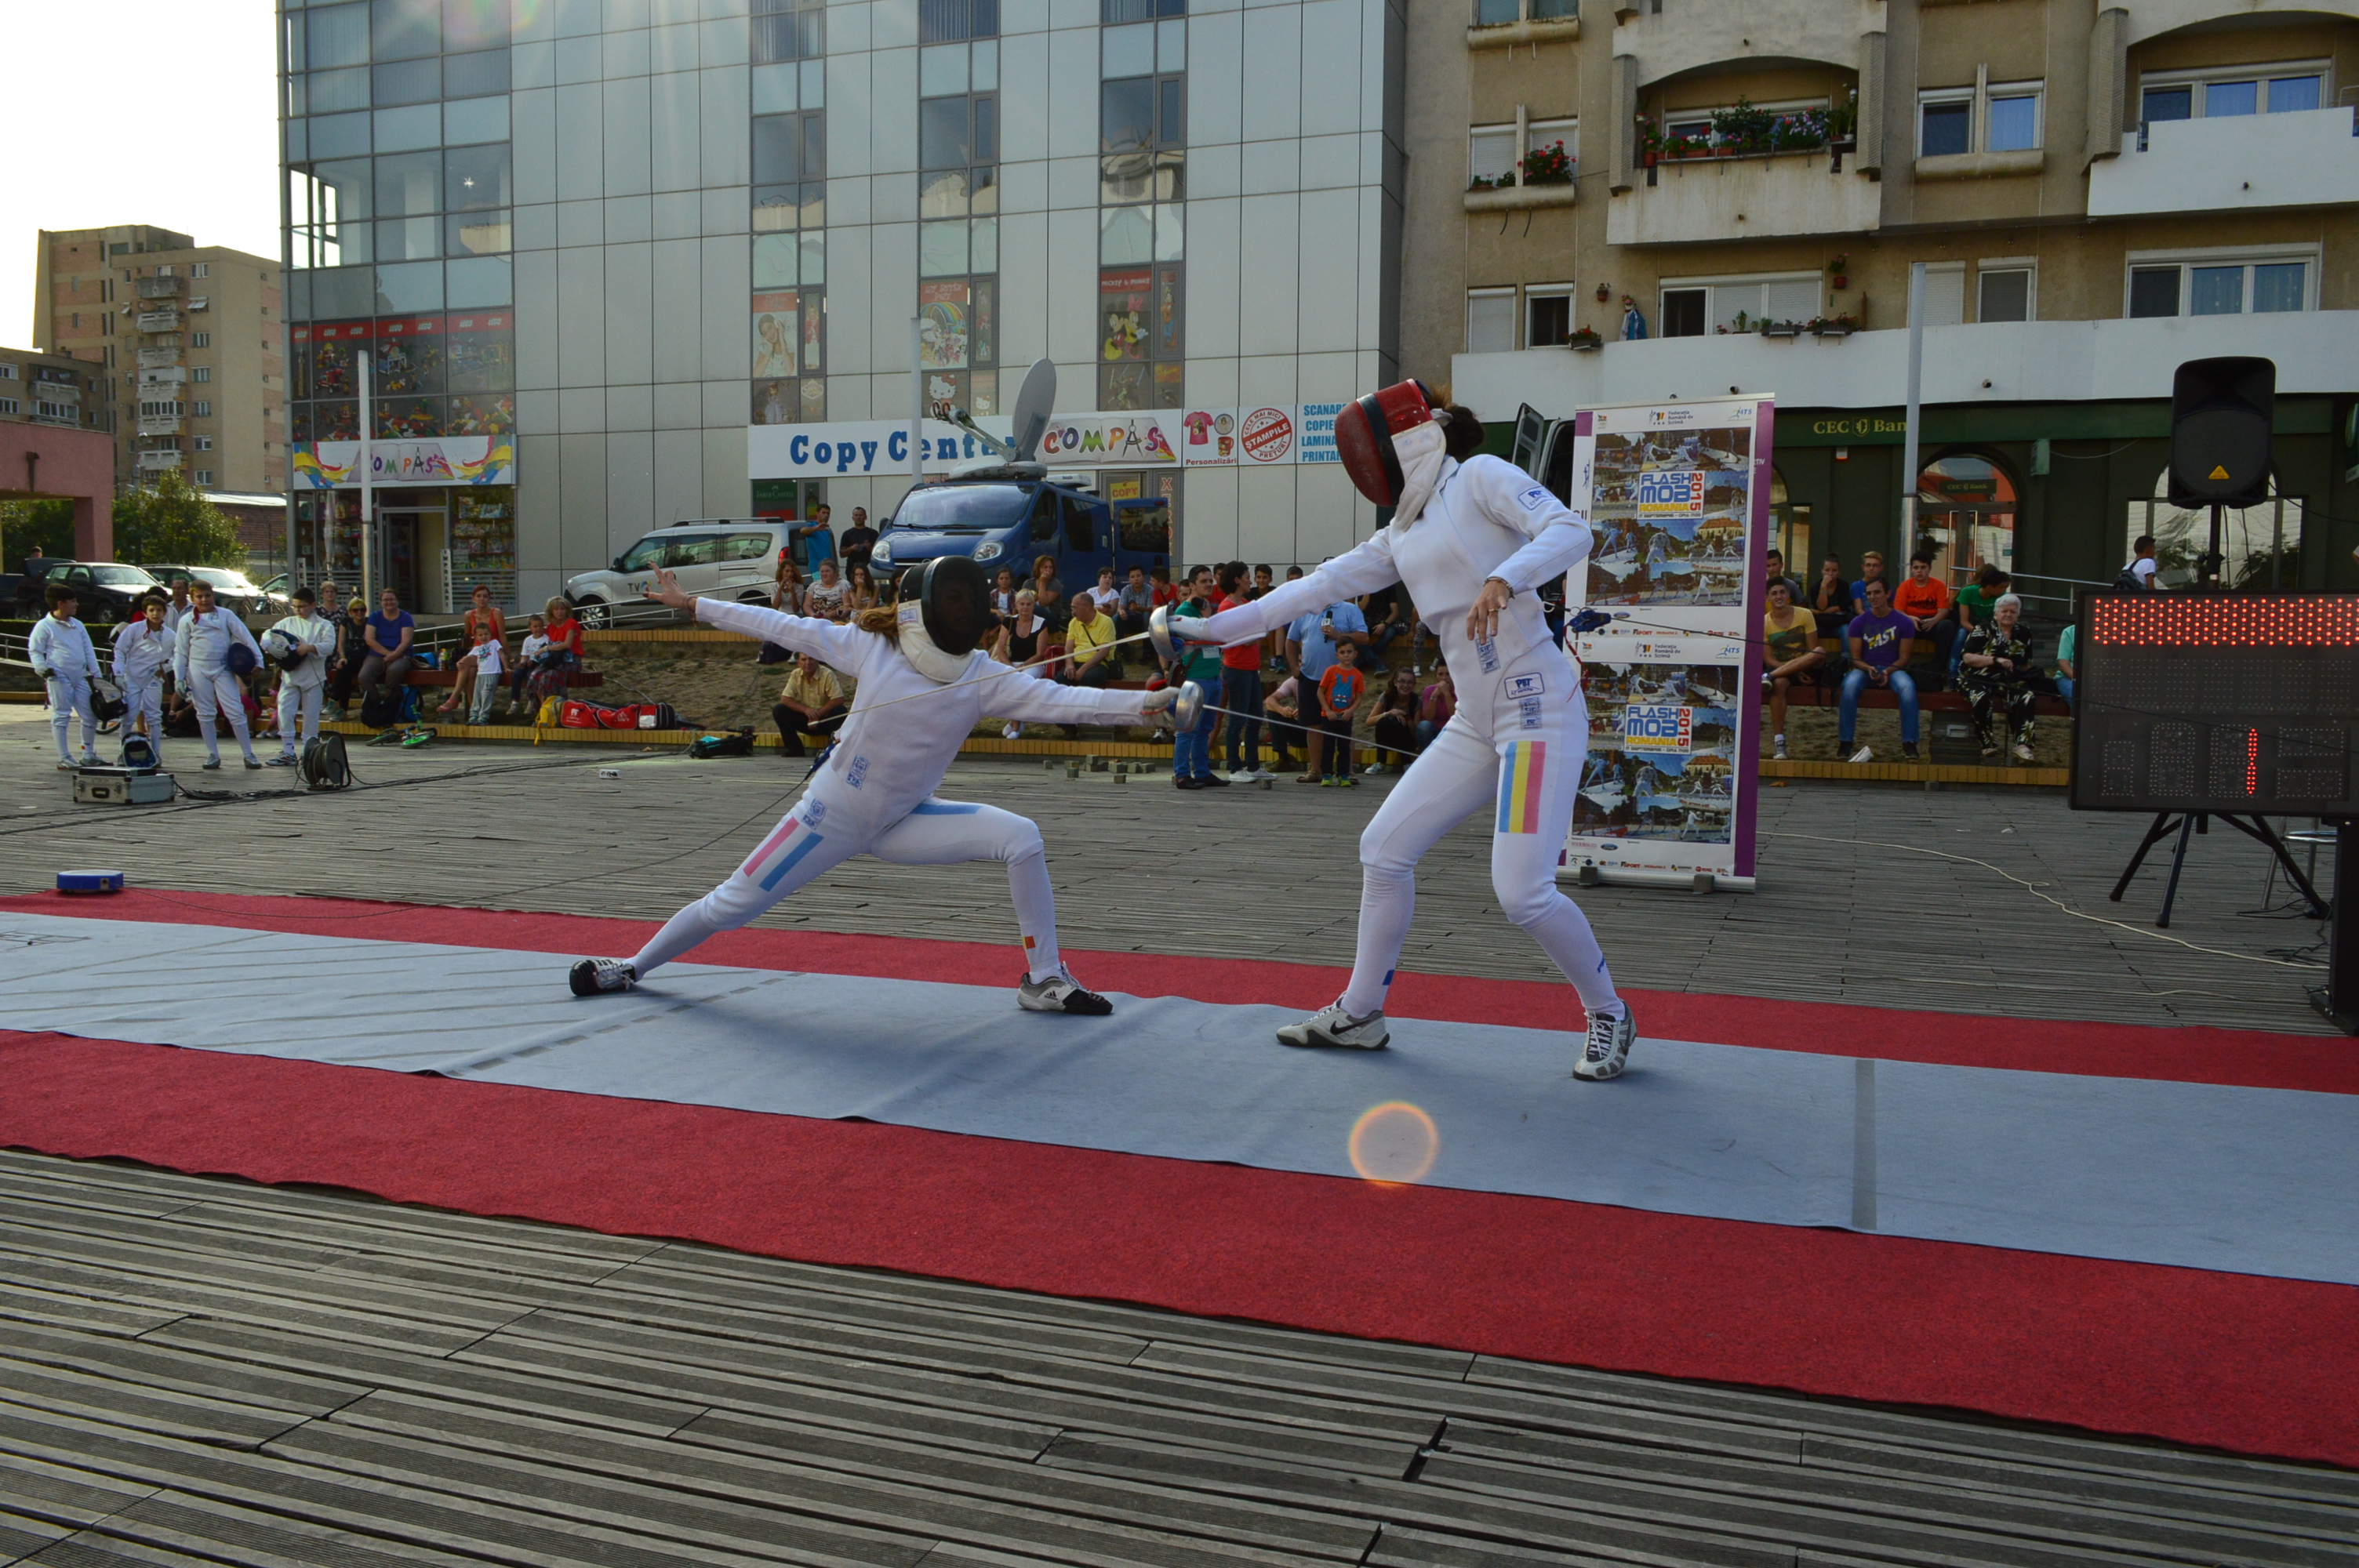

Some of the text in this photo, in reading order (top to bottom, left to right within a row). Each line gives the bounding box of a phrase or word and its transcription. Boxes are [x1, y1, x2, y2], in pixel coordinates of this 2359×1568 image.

[1101, 278, 1121, 287] MICKEY
[389, 324, 403, 332] LEGO
[488, 318, 501, 326] LEGO
[1254, 411, 1267, 419] MAI
[1267, 411, 1281, 419] MICI
[1303, 403, 1347, 416] SCANAR
[1813, 419, 1907, 434] CEC Ban
[1044, 419, 1159, 457] COMPAS
[790, 435, 878, 472] Copy
[370, 447, 433, 474] OMPAS
[1186, 457, 1237, 466] Personalizări
[1112, 487, 1138, 498] COPY
[1640, 485, 1691, 503] MOB
[1641, 473, 1703, 511] FLASH 2015
[1639, 503, 1689, 512] ROMANIA
[1515, 677, 1533, 688] PBT
[1627, 706, 1691, 746] FLASH 2015
[1627, 718, 1678, 737] MOB
[1626, 735, 1677, 746] ROMANIA
